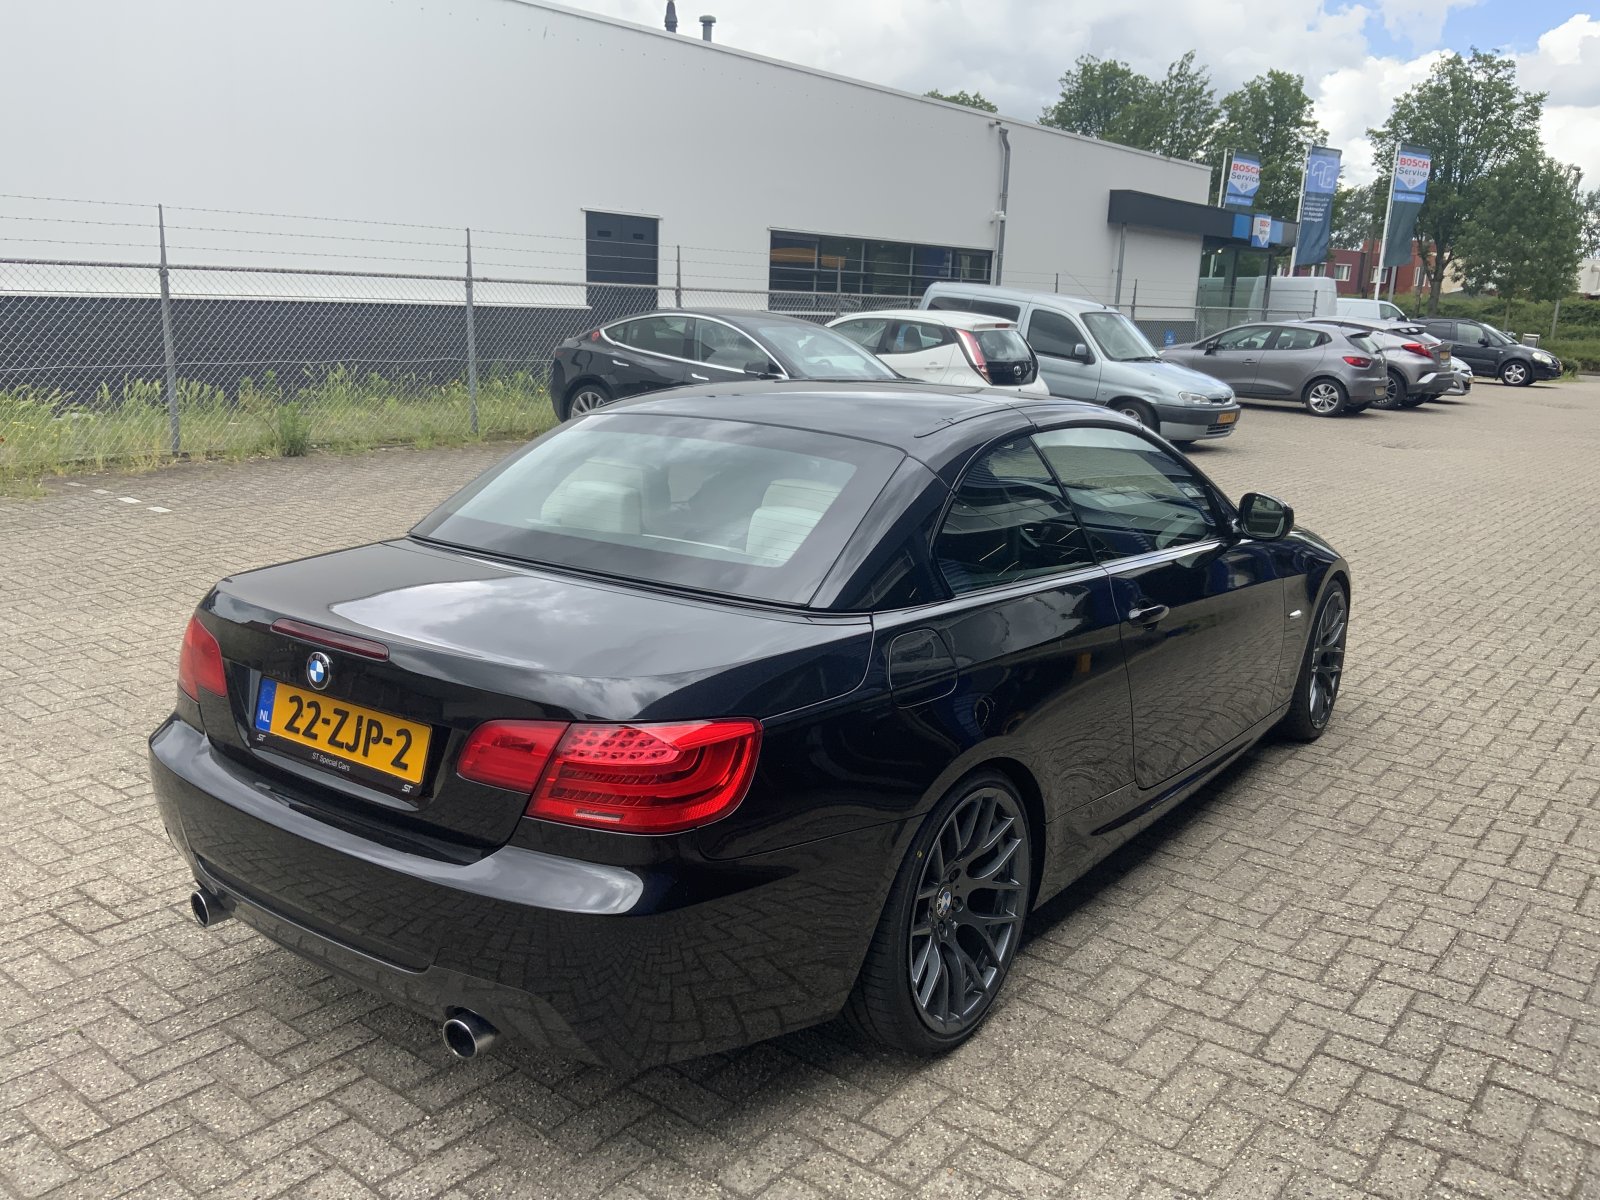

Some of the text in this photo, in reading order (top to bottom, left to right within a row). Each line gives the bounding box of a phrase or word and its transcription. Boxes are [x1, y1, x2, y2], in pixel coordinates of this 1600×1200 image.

[1400, 158, 1429, 168] BOSCH
[1399, 167, 1427, 177] Service
[259, 709, 270, 723] NL
[284, 695, 413, 771] 22-ZJP-2
[311, 752, 350, 772] ST Special Cars
[402, 784, 413, 793] ST
